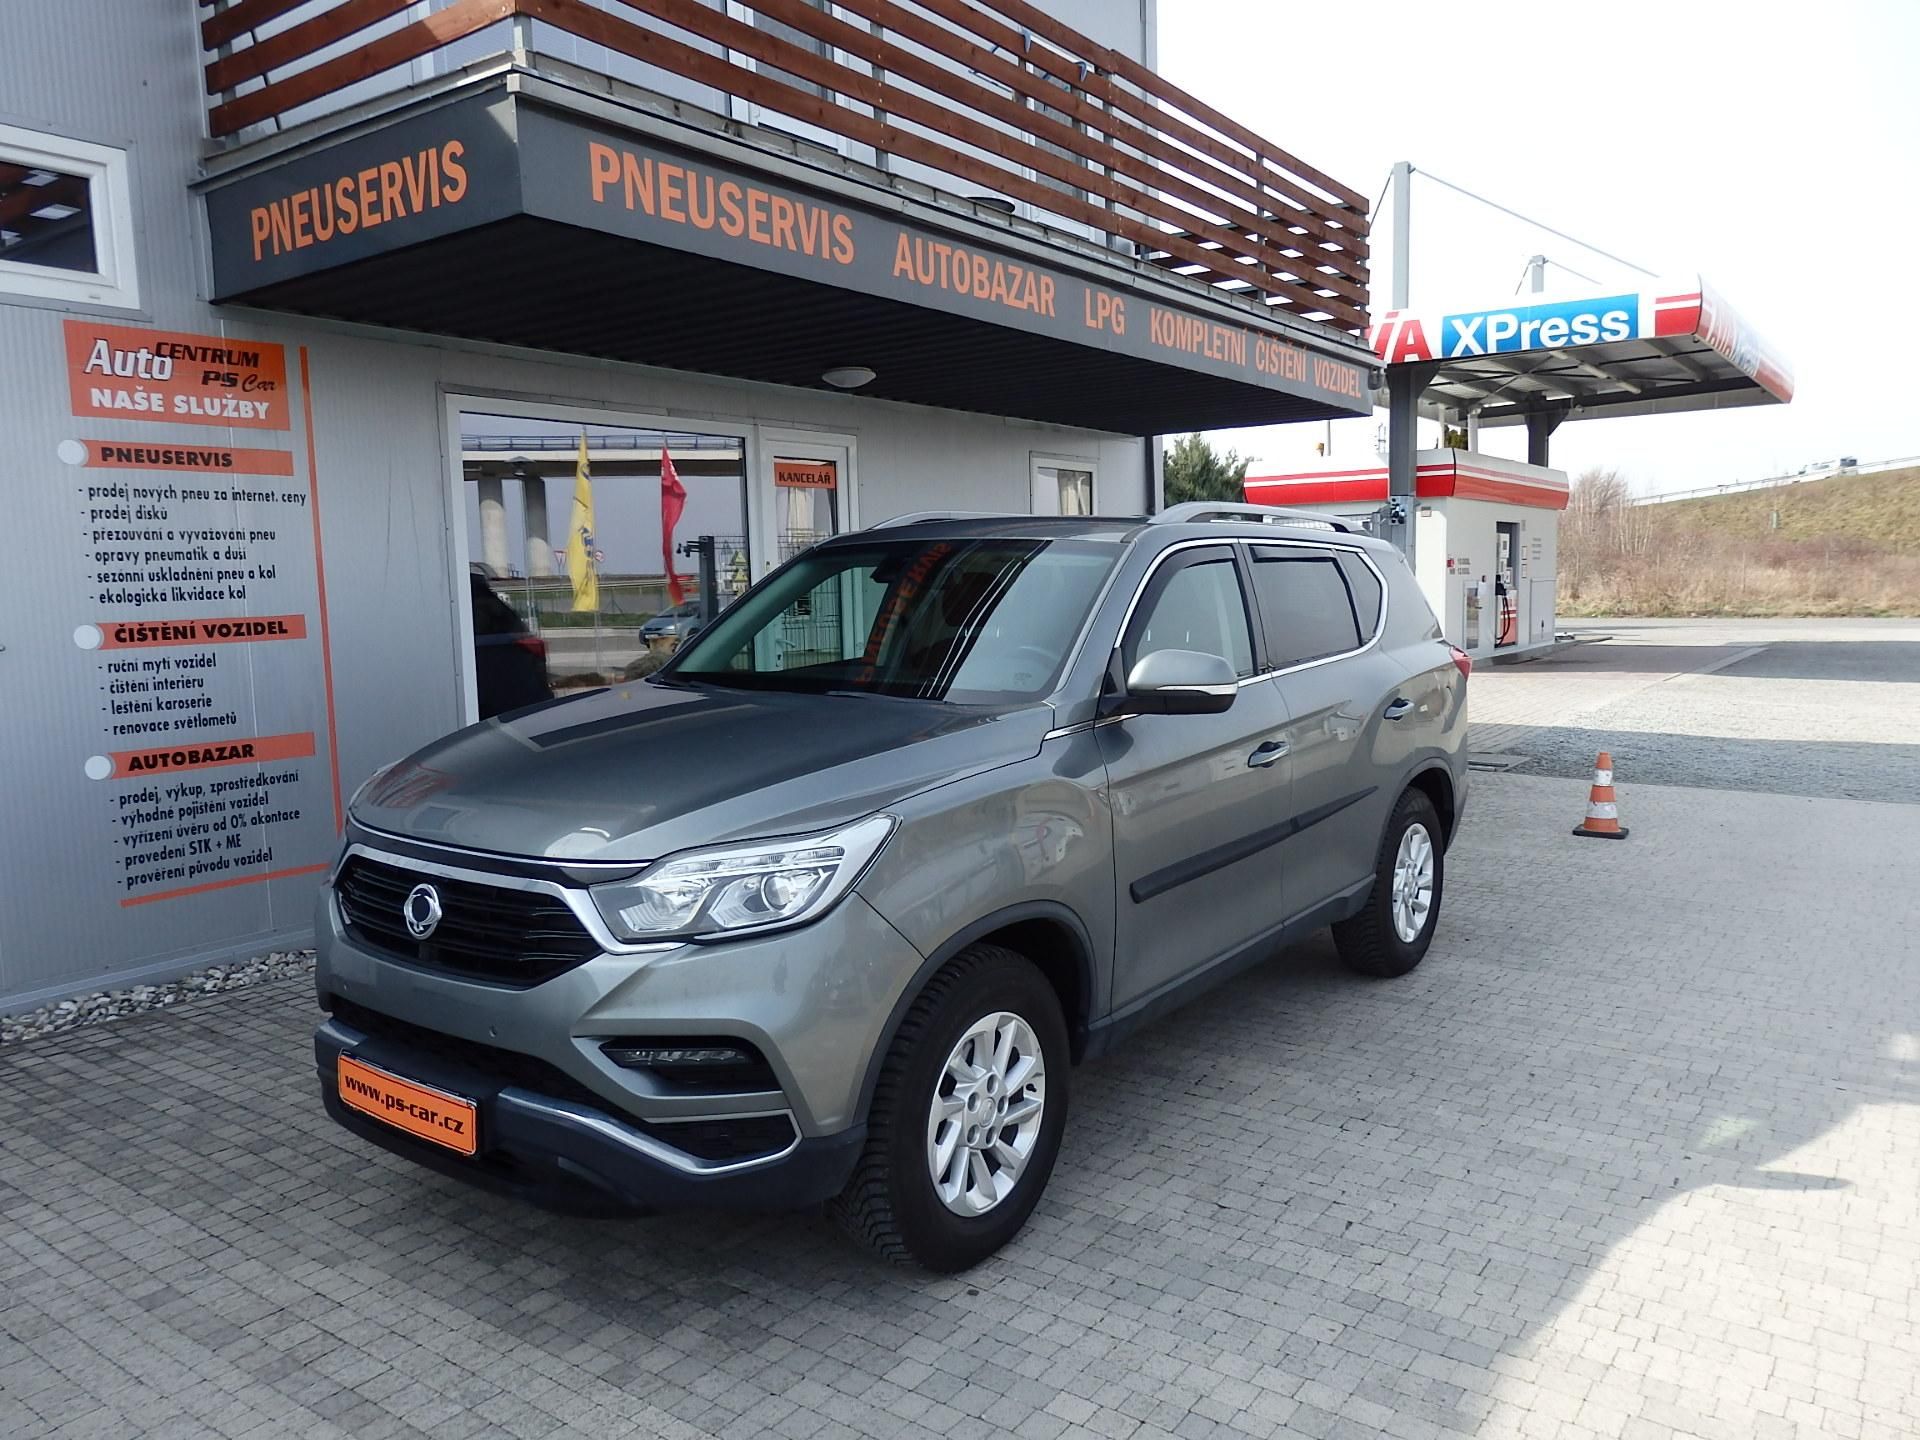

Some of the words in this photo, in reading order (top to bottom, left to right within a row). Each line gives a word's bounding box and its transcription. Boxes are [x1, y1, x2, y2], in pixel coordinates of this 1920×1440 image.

[250, 140, 467, 261] PNEUSERVIS
[589, 142, 855, 265] PNEUSERVIS
[893, 232, 1056, 318] AUTOBAZAR
[1084, 287, 1126, 335] LPG
[1151, 308, 1249, 366] KOMPLETNÍ
[1255, 330, 1307, 383] ČIŠTĚNÍ
[1314, 358, 1362, 398] VOZIDEL
[1448, 310, 1630, 357] XPress
[82, 338, 173, 381] Auto
[155, 341, 259, 369] CENTRUM
[201, 370, 239, 388] PS
[241, 373, 276, 393] Car
[90, 385, 164, 413] NAŠE
[174, 393, 270, 420] SLUŽBY
[101, 446, 233, 468] PNEUSERVIS
[778, 471, 831, 485] KANCELÁŘ
[88, 483, 129, 502] prodej
[133, 484, 177, 501] nových
[182, 489, 209, 502] pneu
[214, 490, 227, 501] za
[232, 487, 278, 502] internet.
[281, 492, 306, 506] ceny
[91, 505, 131, 524] prodej
[136, 505, 168, 520] disků
[93, 527, 163, 545] přezouvání
[167, 531, 174, 541] a
[179, 527, 246, 545] vyvažování
[250, 531, 276, 543] pneu
[95, 550, 139, 566] opravy
[145, 546, 208, 565] pneumatik
[213, 550, 220, 560] a
[97, 568, 144, 583] sezónní
[149, 564, 213, 582] uskladnění
[217, 569, 244, 583] pneu
[248, 569, 255, 580] a
[259, 564, 276, 580] kol
[99, 586, 167, 607] ekologická
[171, 585, 225, 602] likvidace
[229, 584, 246, 600] kol
[114, 620, 196, 643] ČIŠTĚNÍ
[202, 620, 288, 639] VOZIDEL
[107, 657, 138, 674] ruční
[175, 652, 217, 670] vozidel
[110, 678, 149, 694] čištění
[153, 674, 204, 691] interiéru
[111, 698, 153, 715] leštění
[156, 695, 212, 711] karoserie
[113, 721, 169, 736] renovace
[174, 710, 237, 730] světlometů
[128, 743, 255, 772] AUTOBAZAR
[166, 782, 206, 800] výkup,
[210, 768, 299, 796] zprostředkování
[121, 808, 174, 828] výhodné
[178, 801, 226, 821] pojištění
[230, 791, 269, 810] vozidel
[123, 829, 173, 849] vyřízení
[176, 822, 209, 840] úvěru
[213, 817, 227, 832] od
[231, 814, 247, 829] 0%
[251, 808, 300, 826] akontace
[125, 849, 185, 871] provedení
[189, 838, 212, 857] STK
[226, 833, 242, 849] ME
[127, 869, 185, 890] prověření
[189, 858, 230, 877] původu
[234, 847, 273, 867] vozidel
[344, 1075, 465, 1135] www.ps-car.cz
